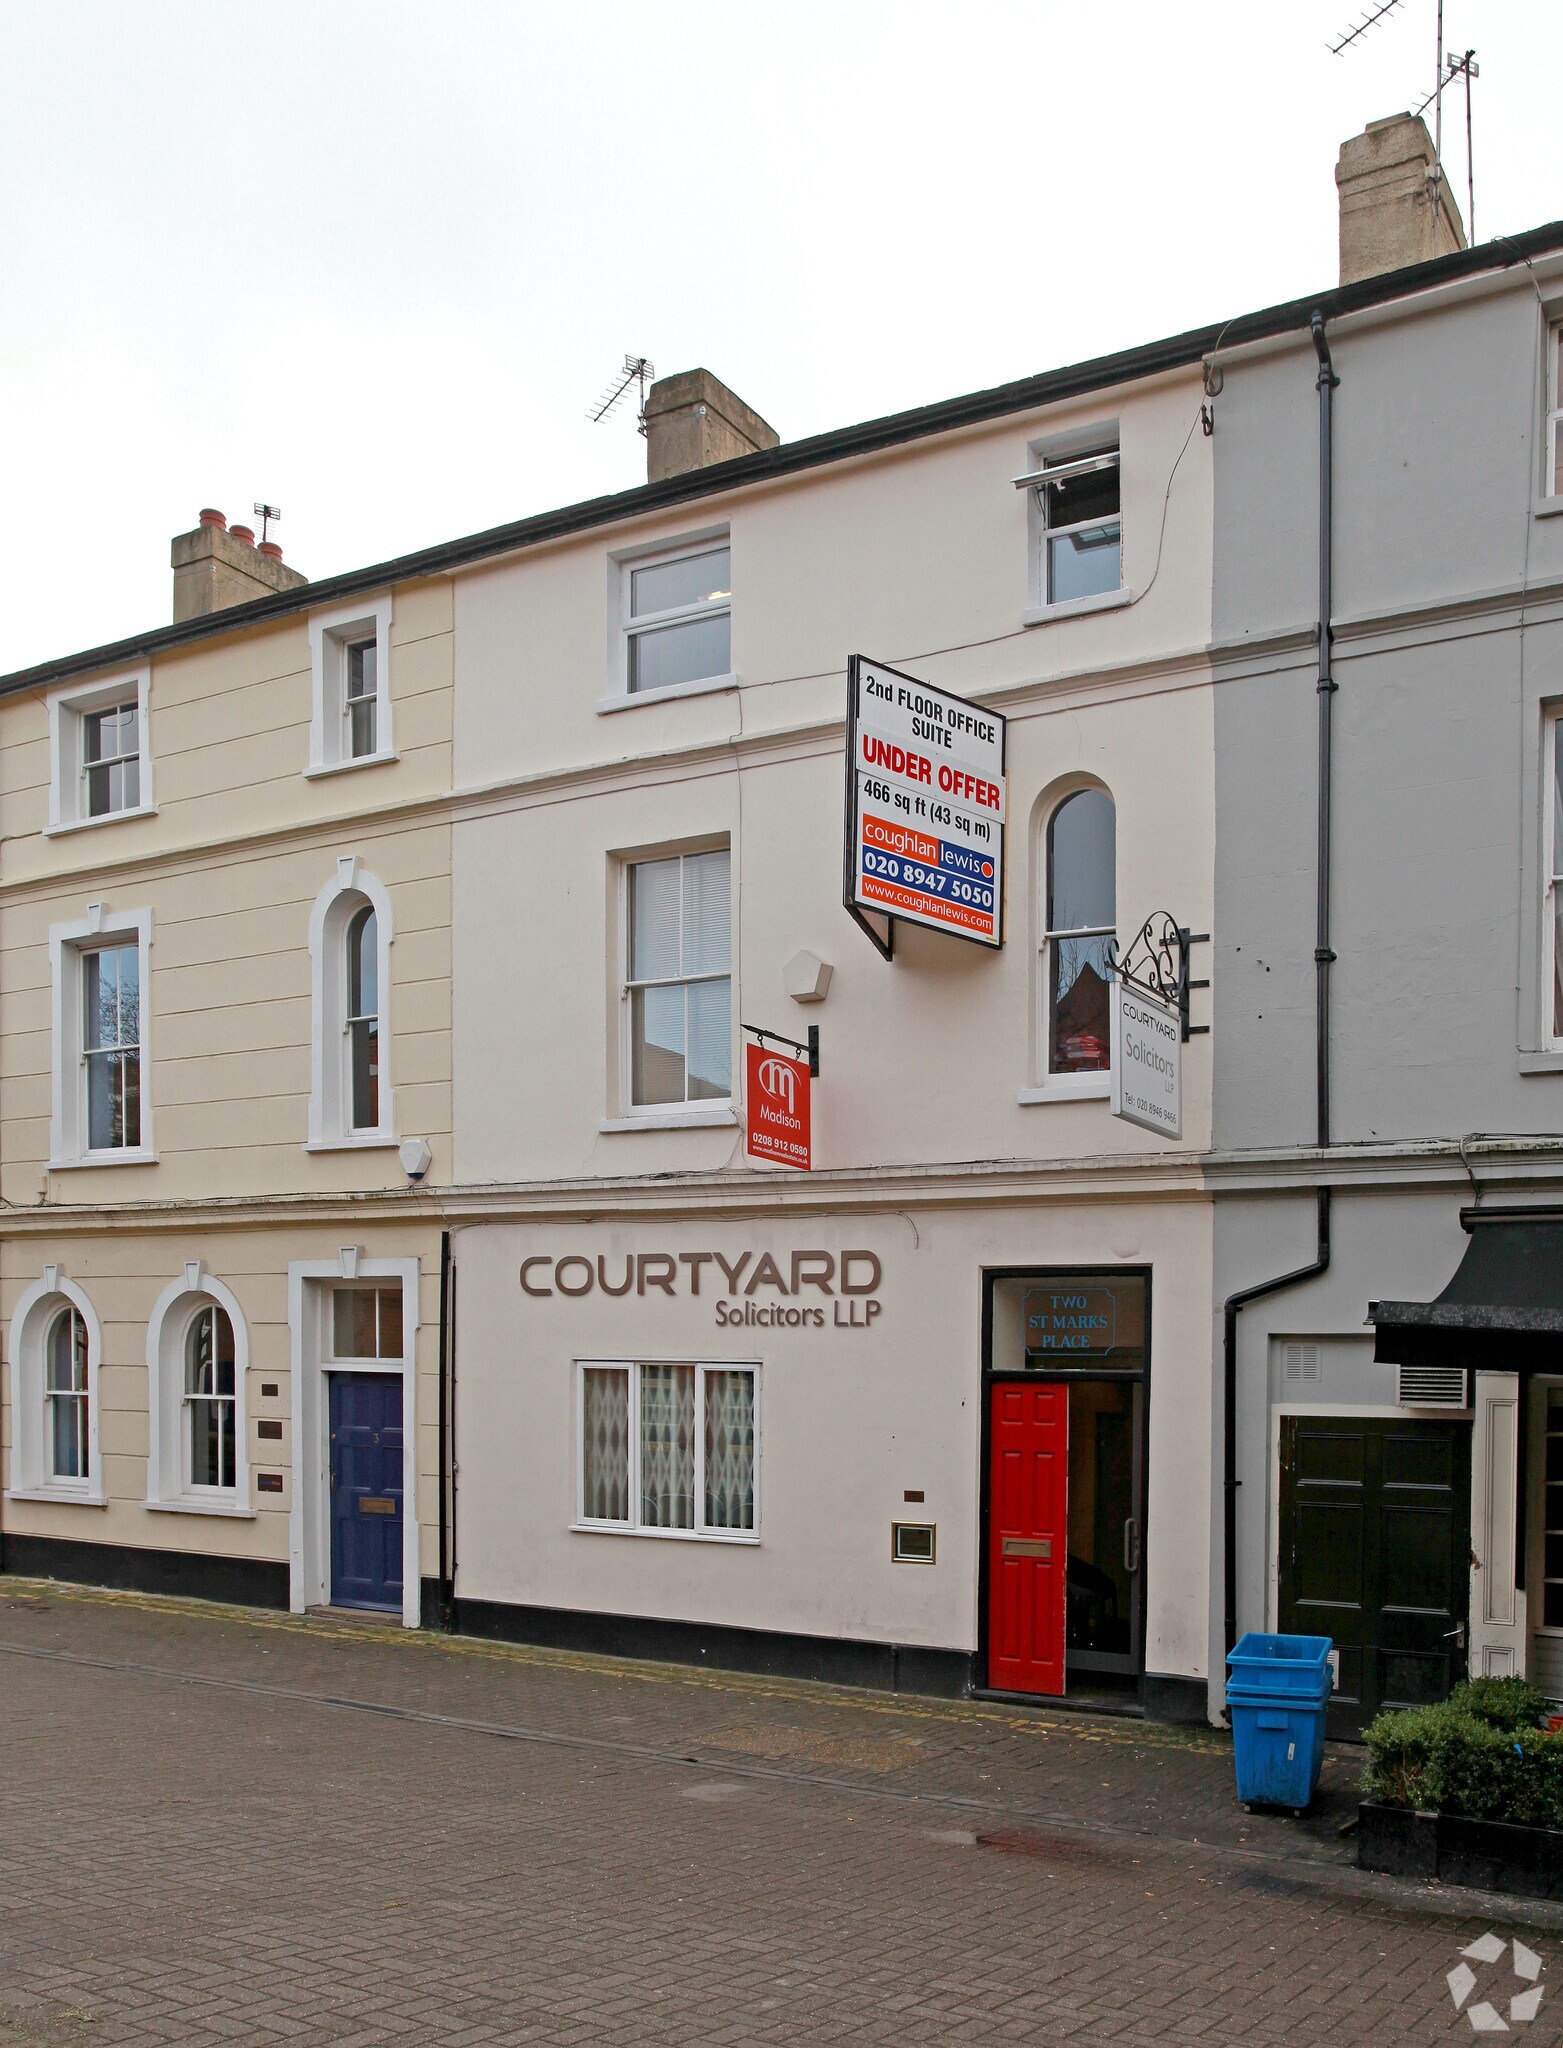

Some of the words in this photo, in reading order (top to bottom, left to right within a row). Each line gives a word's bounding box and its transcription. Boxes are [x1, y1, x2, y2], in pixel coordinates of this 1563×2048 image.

[866, 675, 893, 702] 2nd
[898, 688, 943, 723] FLOOR
[947, 709, 995, 744] OFFICE
[912, 717, 952, 749] SUITE
[863, 733, 932, 786] UNDER
[938, 765, 1000, 811] OFFER
[864, 779, 891, 803] 466
[894, 792, 910, 815] sq
[915, 797, 926, 817] ft
[930, 803, 951, 825] (43
[955, 815, 970, 836] sq
[975, 822, 991, 843] m)
[865, 823, 936, 859] coughlan
[940, 844, 980, 874] lewis
[865, 852, 899, 877] 020
[903, 864, 947, 892] 8947
[951, 880, 992, 908] 5050
[864, 881, 992, 930] www.coughlanlewis.com
[1122, 1002, 1177, 1042] COURTYARD
[1126, 1033, 1175, 1079] Solicitors
[1164, 1079, 1175, 1095] LLP
[760, 1103, 801, 1131] Madison
[1137, 1097, 1148, 1112] 020
[752, 1132, 773, 1147] 0208
[774, 1138, 788, 1151] 912
[519, 1249, 882, 1297] COURTYARD
[714, 1300, 825, 1328] Solicitors
[833, 1299, 882, 1328] LLP
[1050, 1295, 1087, 1310] TWO
[1029, 1315, 1049, 1329] ST
[1053, 1315, 1109, 1329] MARKS
[1042, 1334, 1090, 1349] PLACE
[373, 1433, 379, 1443] 3
